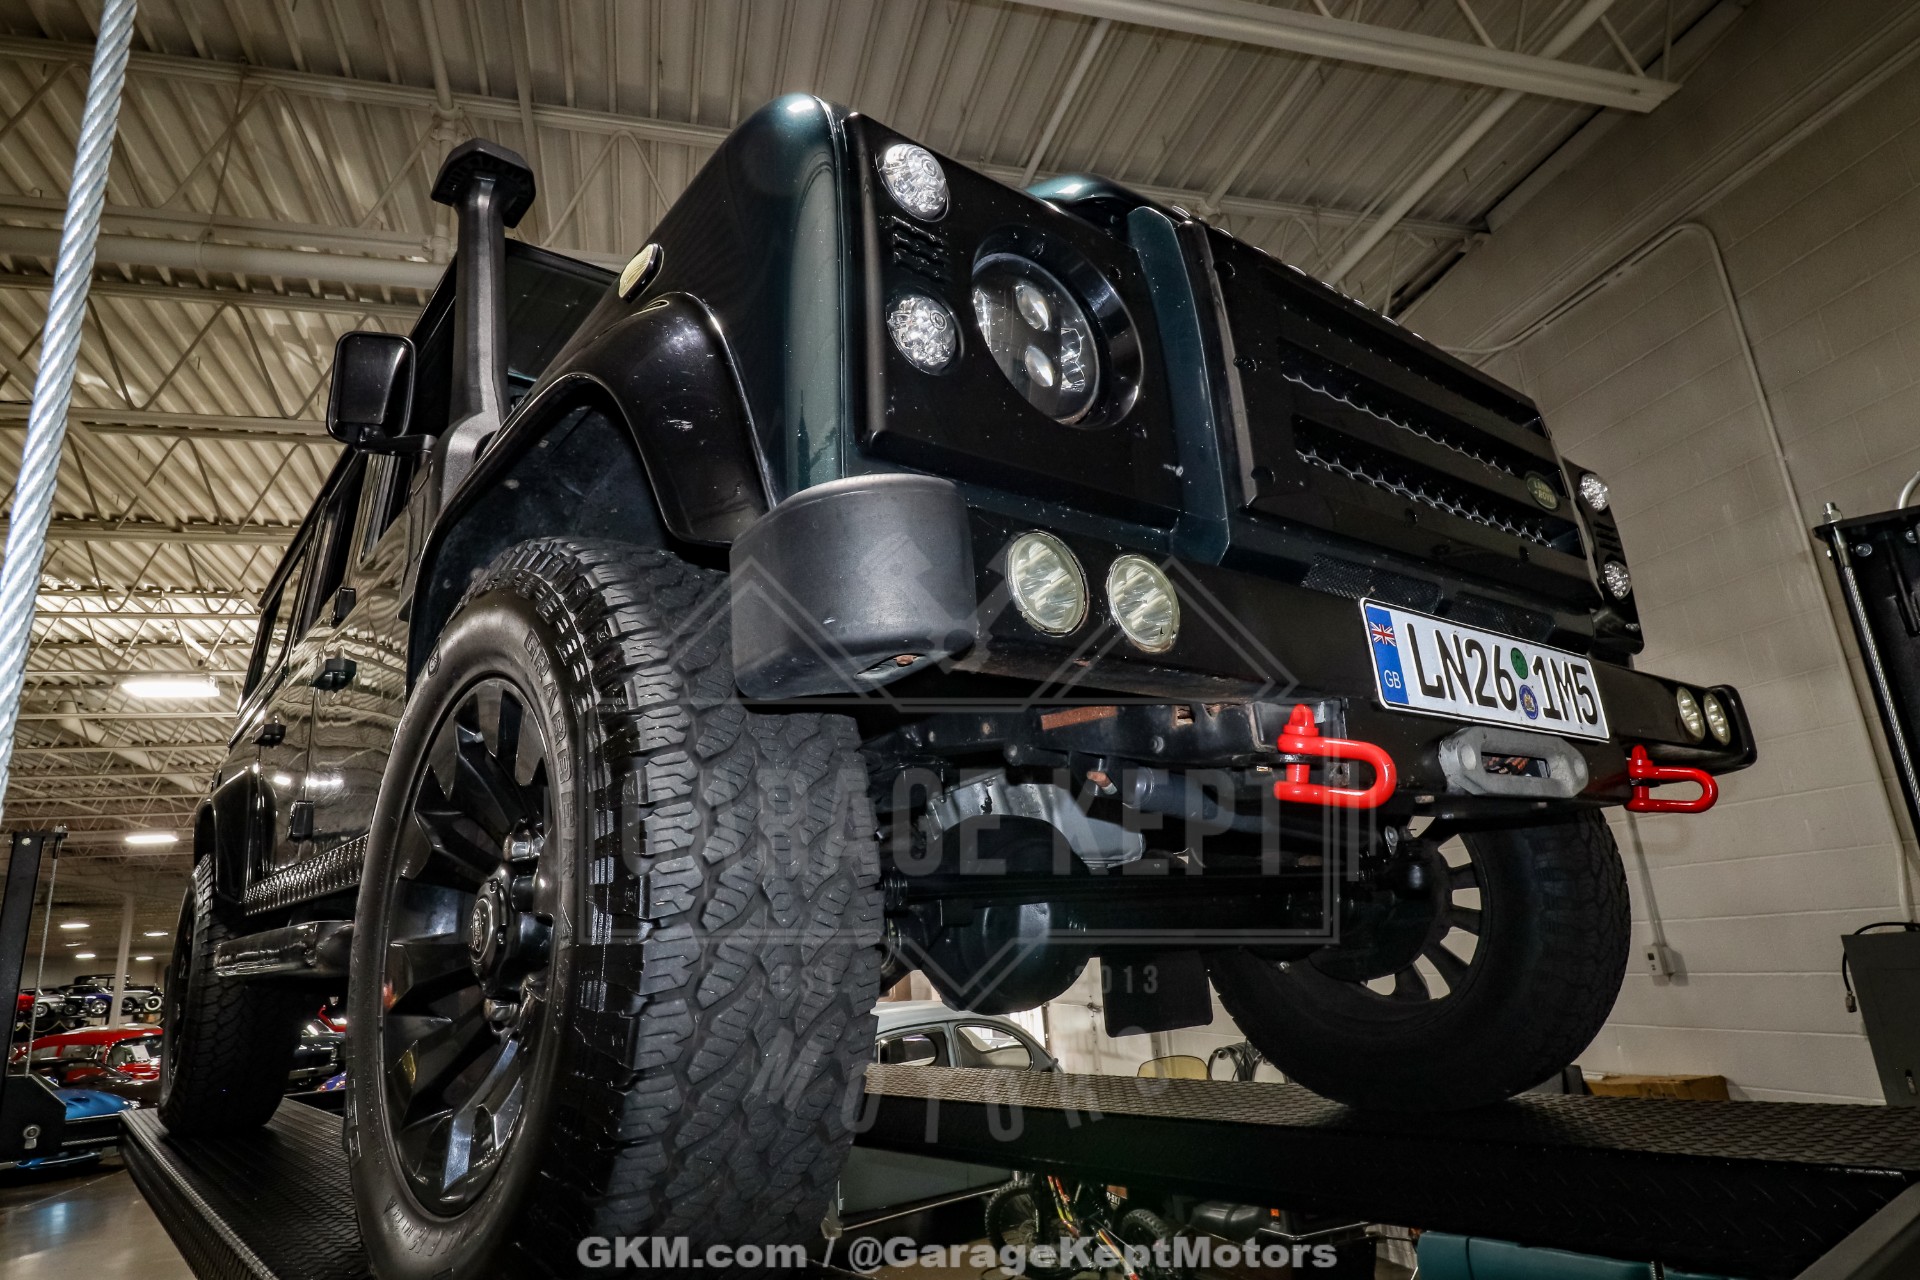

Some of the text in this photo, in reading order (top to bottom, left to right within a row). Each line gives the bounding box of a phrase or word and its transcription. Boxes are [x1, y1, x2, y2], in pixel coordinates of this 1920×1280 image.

[1537, 489, 1557, 505] ROVER
[1384, 669, 1402, 690] GB
[1406, 623, 1518, 712] LN26
[1531, 655, 1599, 726] 1M5
[524, 628, 577, 880] GRABBER
